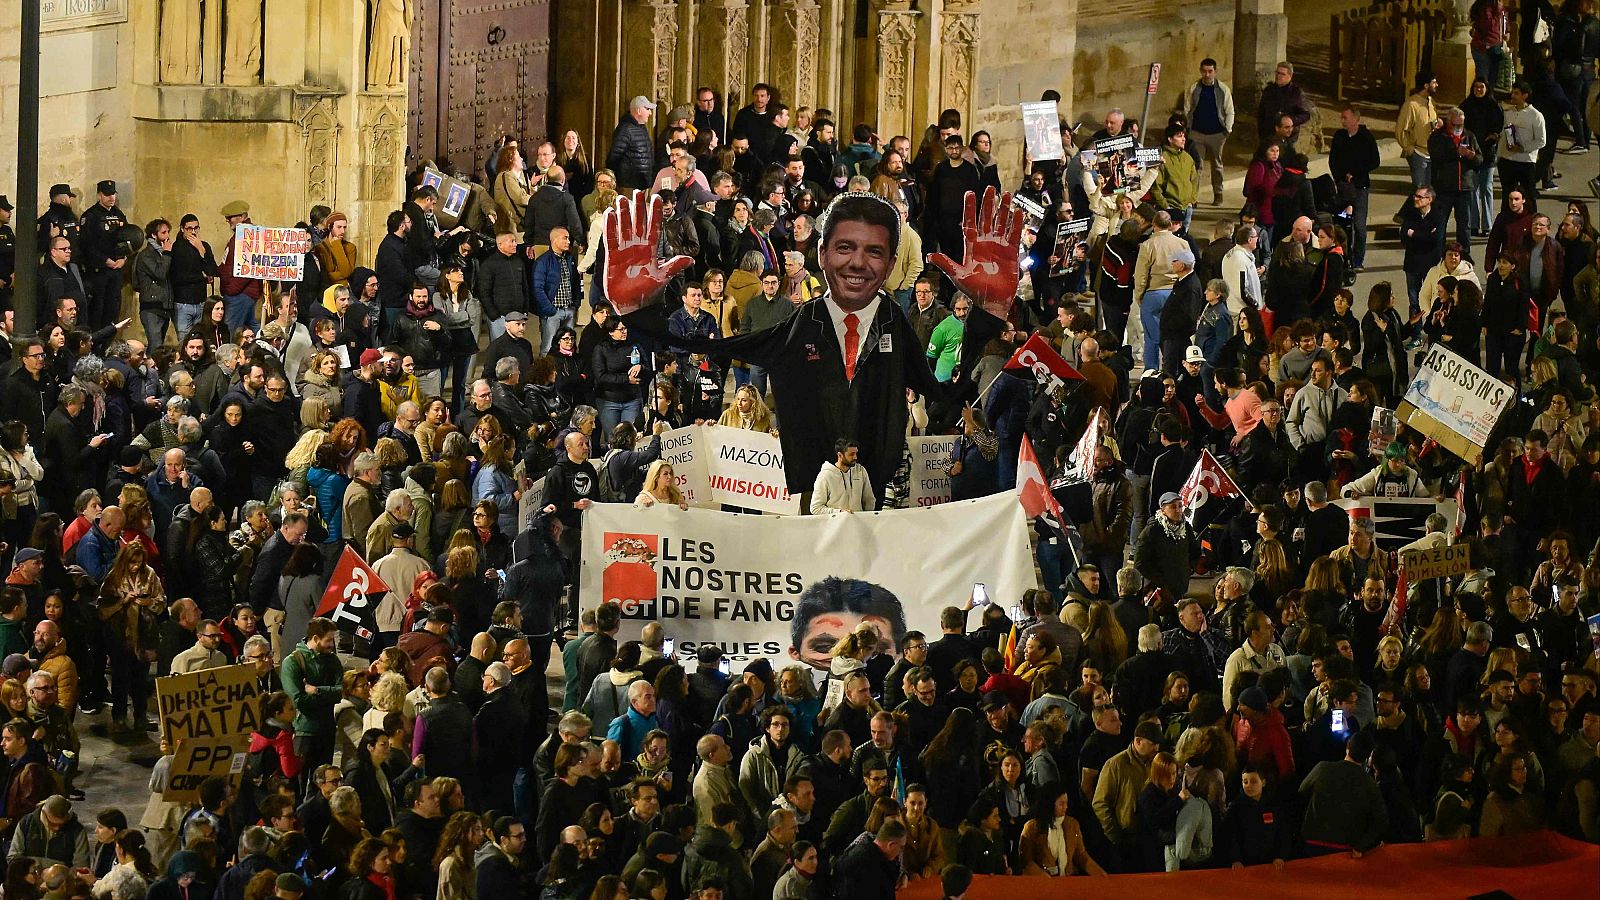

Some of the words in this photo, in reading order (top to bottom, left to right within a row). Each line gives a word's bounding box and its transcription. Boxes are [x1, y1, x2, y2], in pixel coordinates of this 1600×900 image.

[1018, 349, 1065, 396] CGT
[720, 444, 784, 469] MAZÓN
[925, 459, 942, 470] RES
[708, 475, 778, 500] IMISIÓN
[921, 478, 950, 490] FORTA
[662, 538, 715, 564] LES
[661, 566, 803, 595] NOSTRES
[332, 567, 370, 623] CGT
[661, 596, 701, 619] DE
[713, 597, 795, 622] FANG
[679, 641, 781, 655] SUES
[197, 672, 219, 688] LA
[161, 681, 257, 715] DERECHA
[165, 701, 259, 746] MATA
[187, 745, 232, 772] PP
